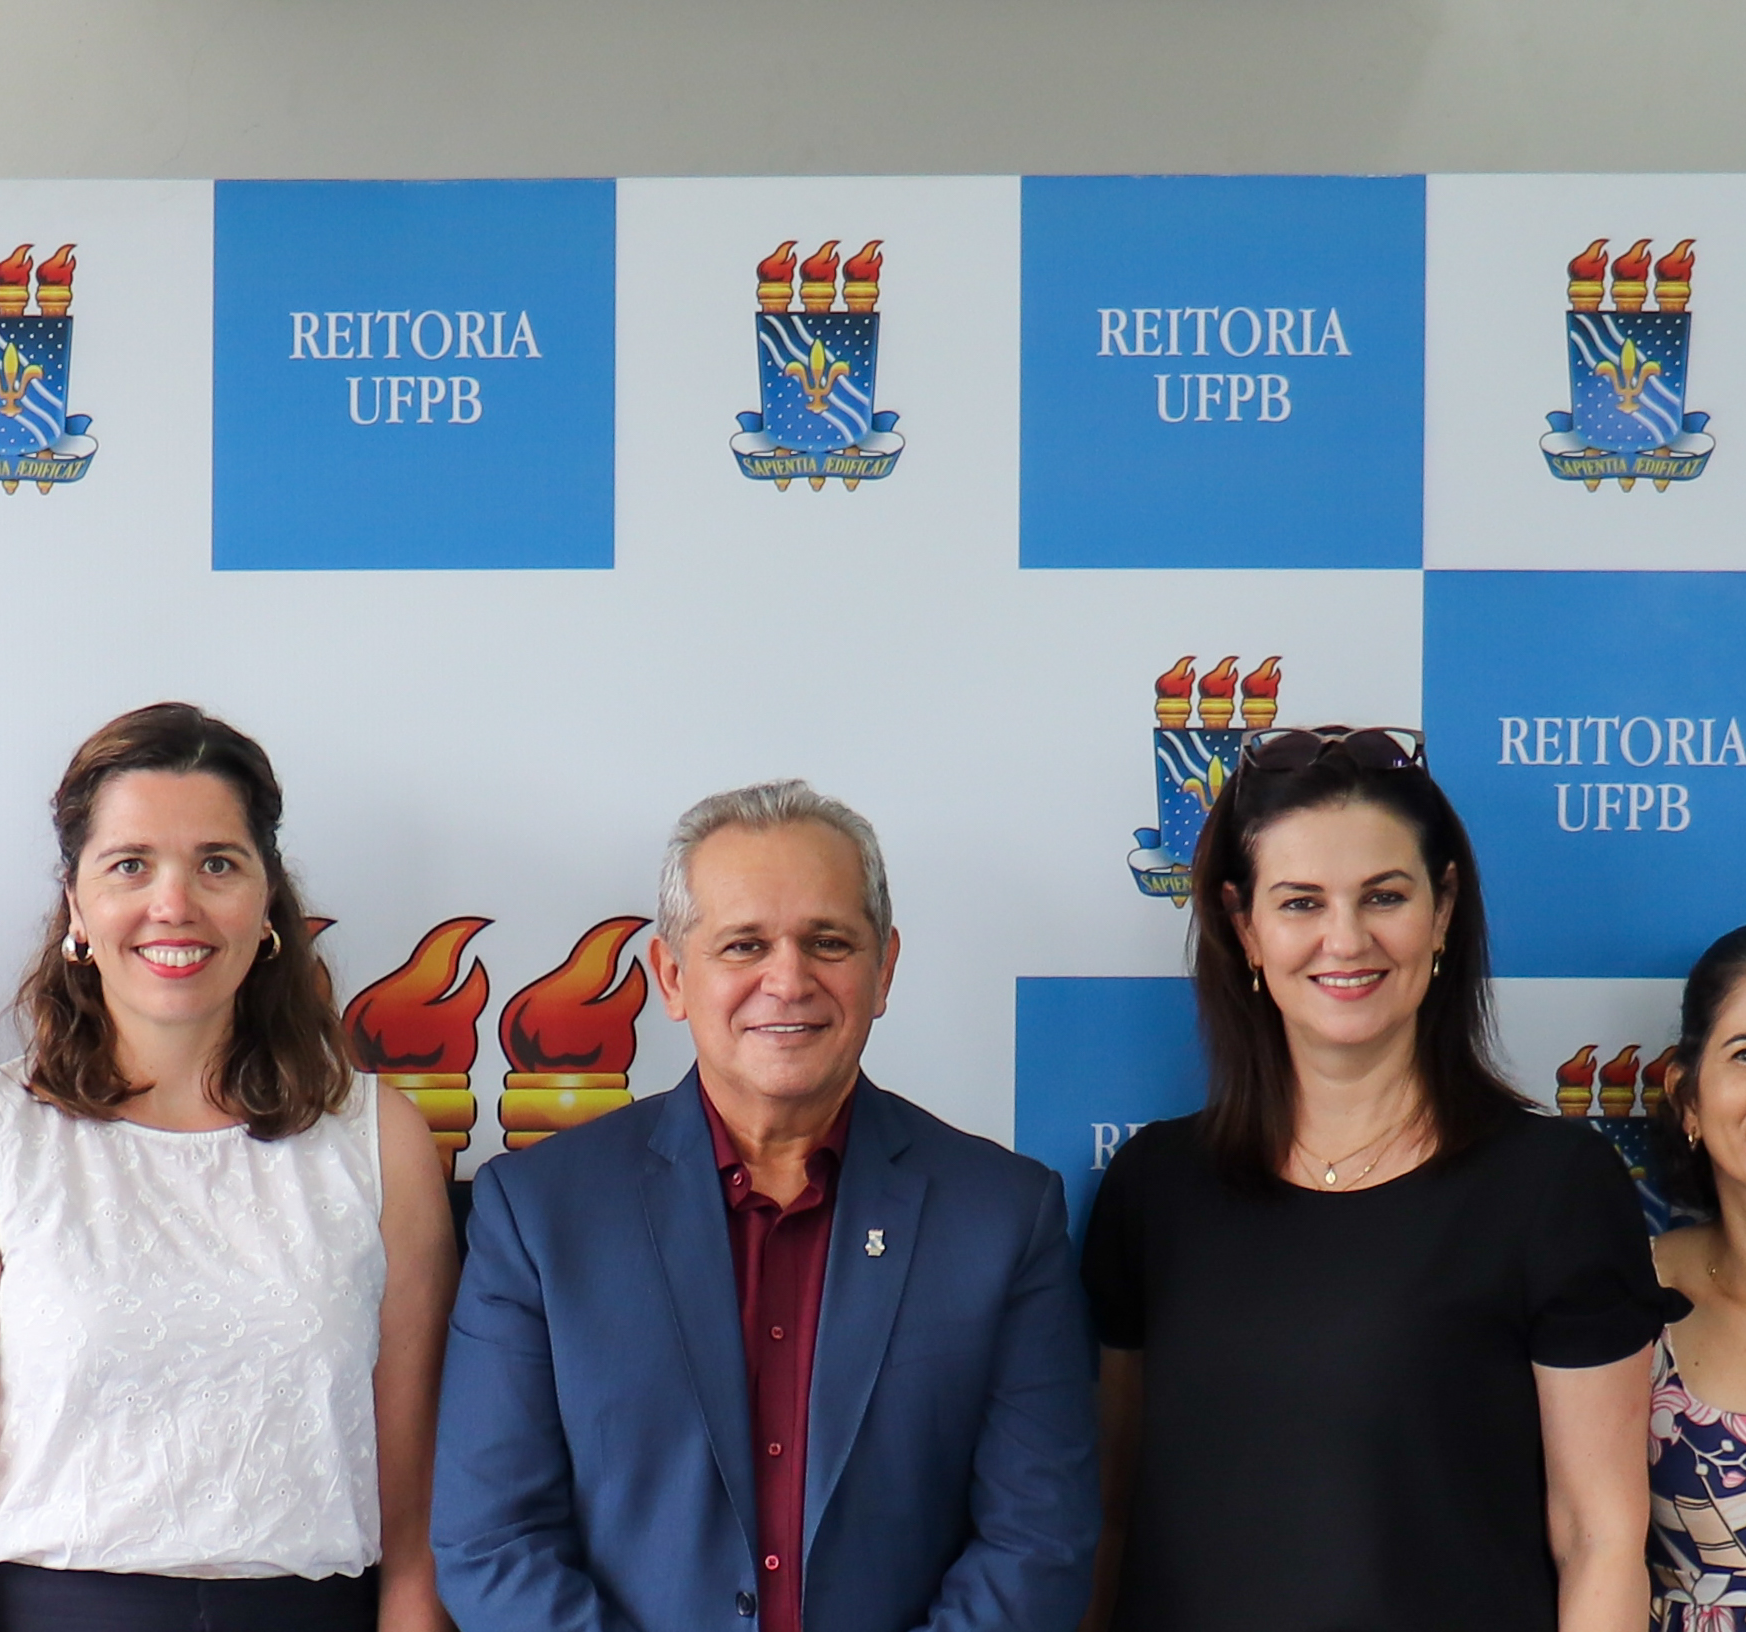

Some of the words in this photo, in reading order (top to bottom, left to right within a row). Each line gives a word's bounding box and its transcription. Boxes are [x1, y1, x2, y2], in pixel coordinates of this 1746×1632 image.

[289, 310, 542, 360] REITORIA
[1097, 307, 1352, 357] REITORIA
[346, 376, 482, 425] UFPB
[1154, 374, 1291, 422] UFPB
[743, 456, 816, 477] SAPIENTIA
[1553, 457, 1626, 477] SAPIENTIA
[1554, 783, 1691, 832] UFPB
